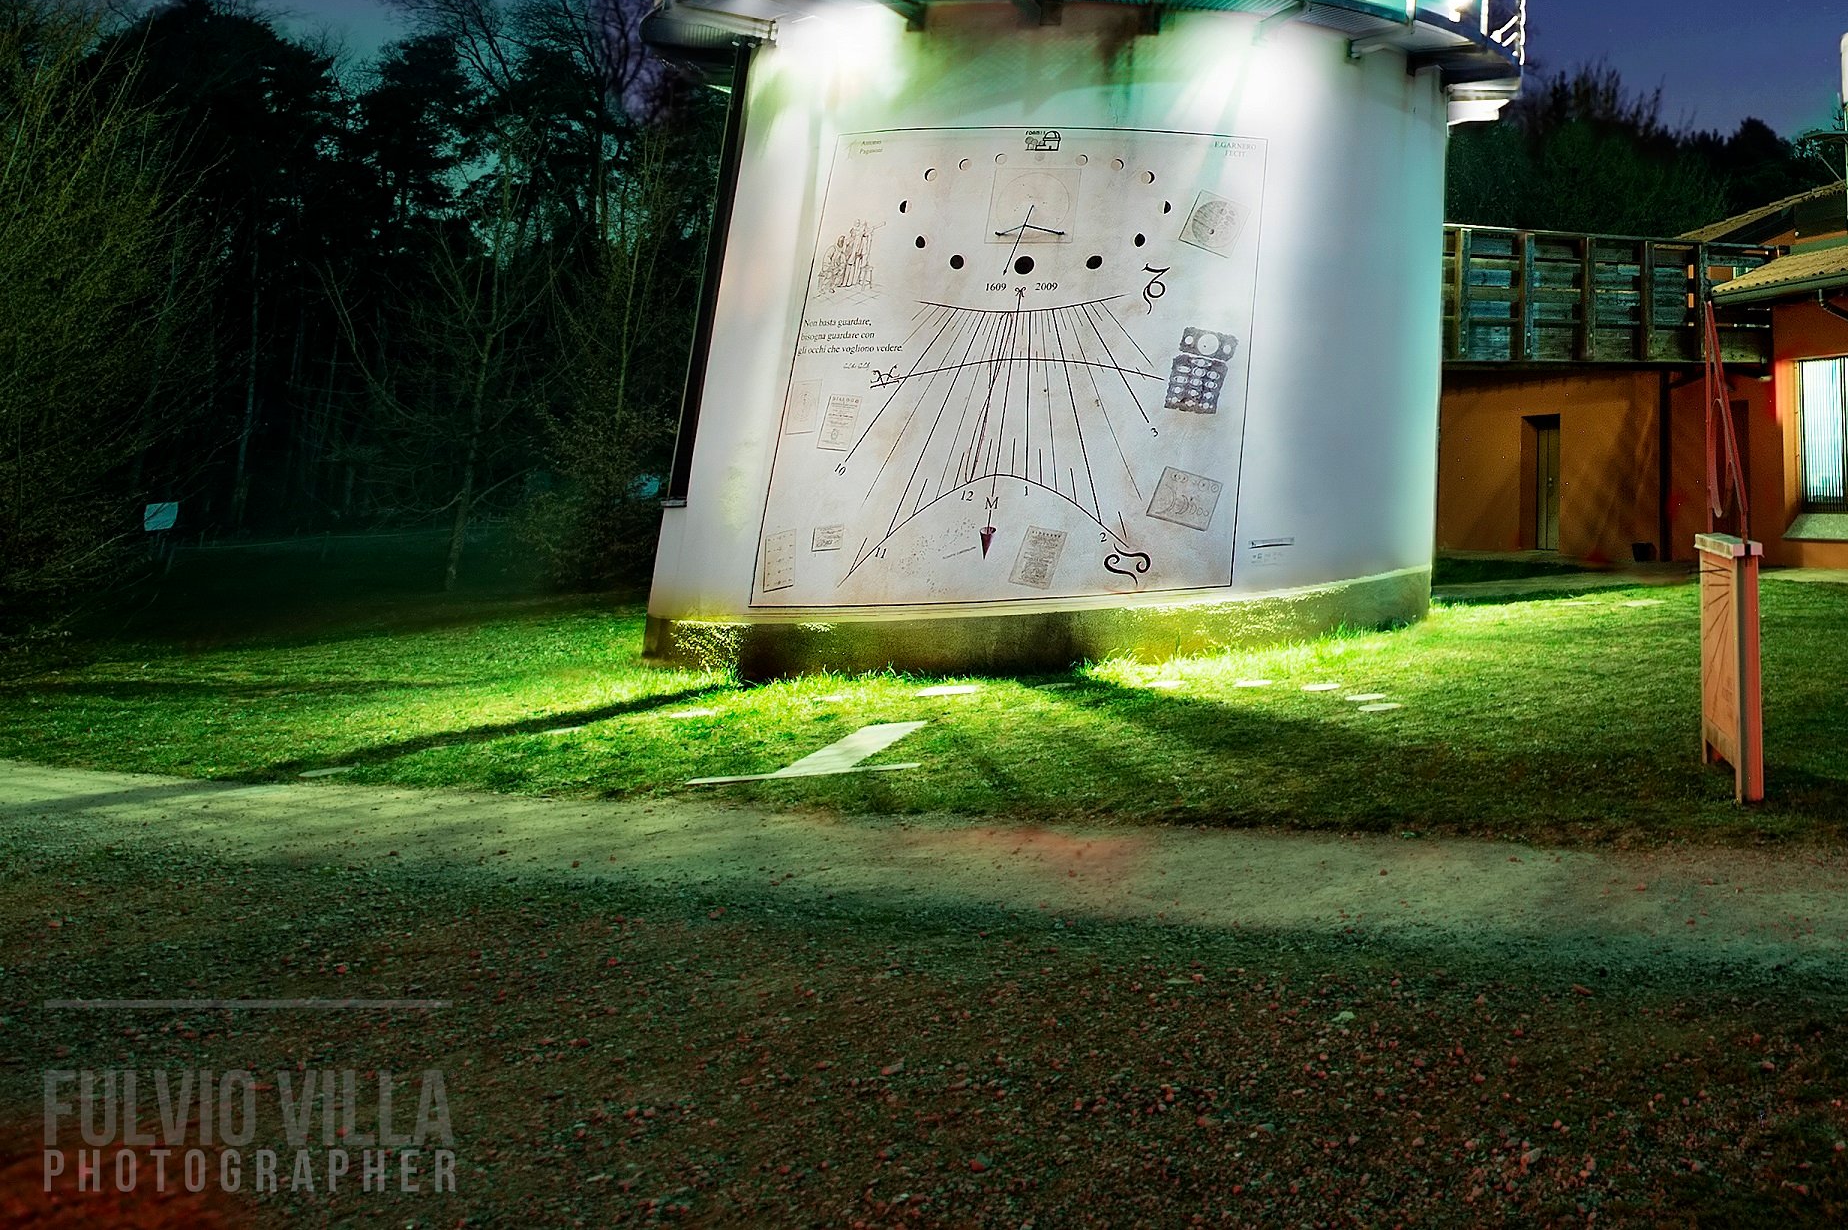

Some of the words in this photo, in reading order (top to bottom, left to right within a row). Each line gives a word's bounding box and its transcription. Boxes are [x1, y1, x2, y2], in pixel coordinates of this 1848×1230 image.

[985, 282, 1007, 292] 1609
[1034, 282, 1059, 291] 2009
[803, 318, 818, 328] Non
[818, 317, 837, 326] basta
[800, 332, 826, 342] bisogna
[826, 331, 859, 341] guardare
[797, 345, 807, 356] gli
[807, 345, 827, 354] occhi
[827, 344, 840, 353] che
[1150, 427, 1159, 438] 3
[834, 462, 847, 476] 10
[960, 490, 974, 501] 12
[1023, 485, 1029, 497] 1
[984, 496, 999, 510] M
[1099, 532, 1108, 542] 2
[873, 546, 888, 560] 11
